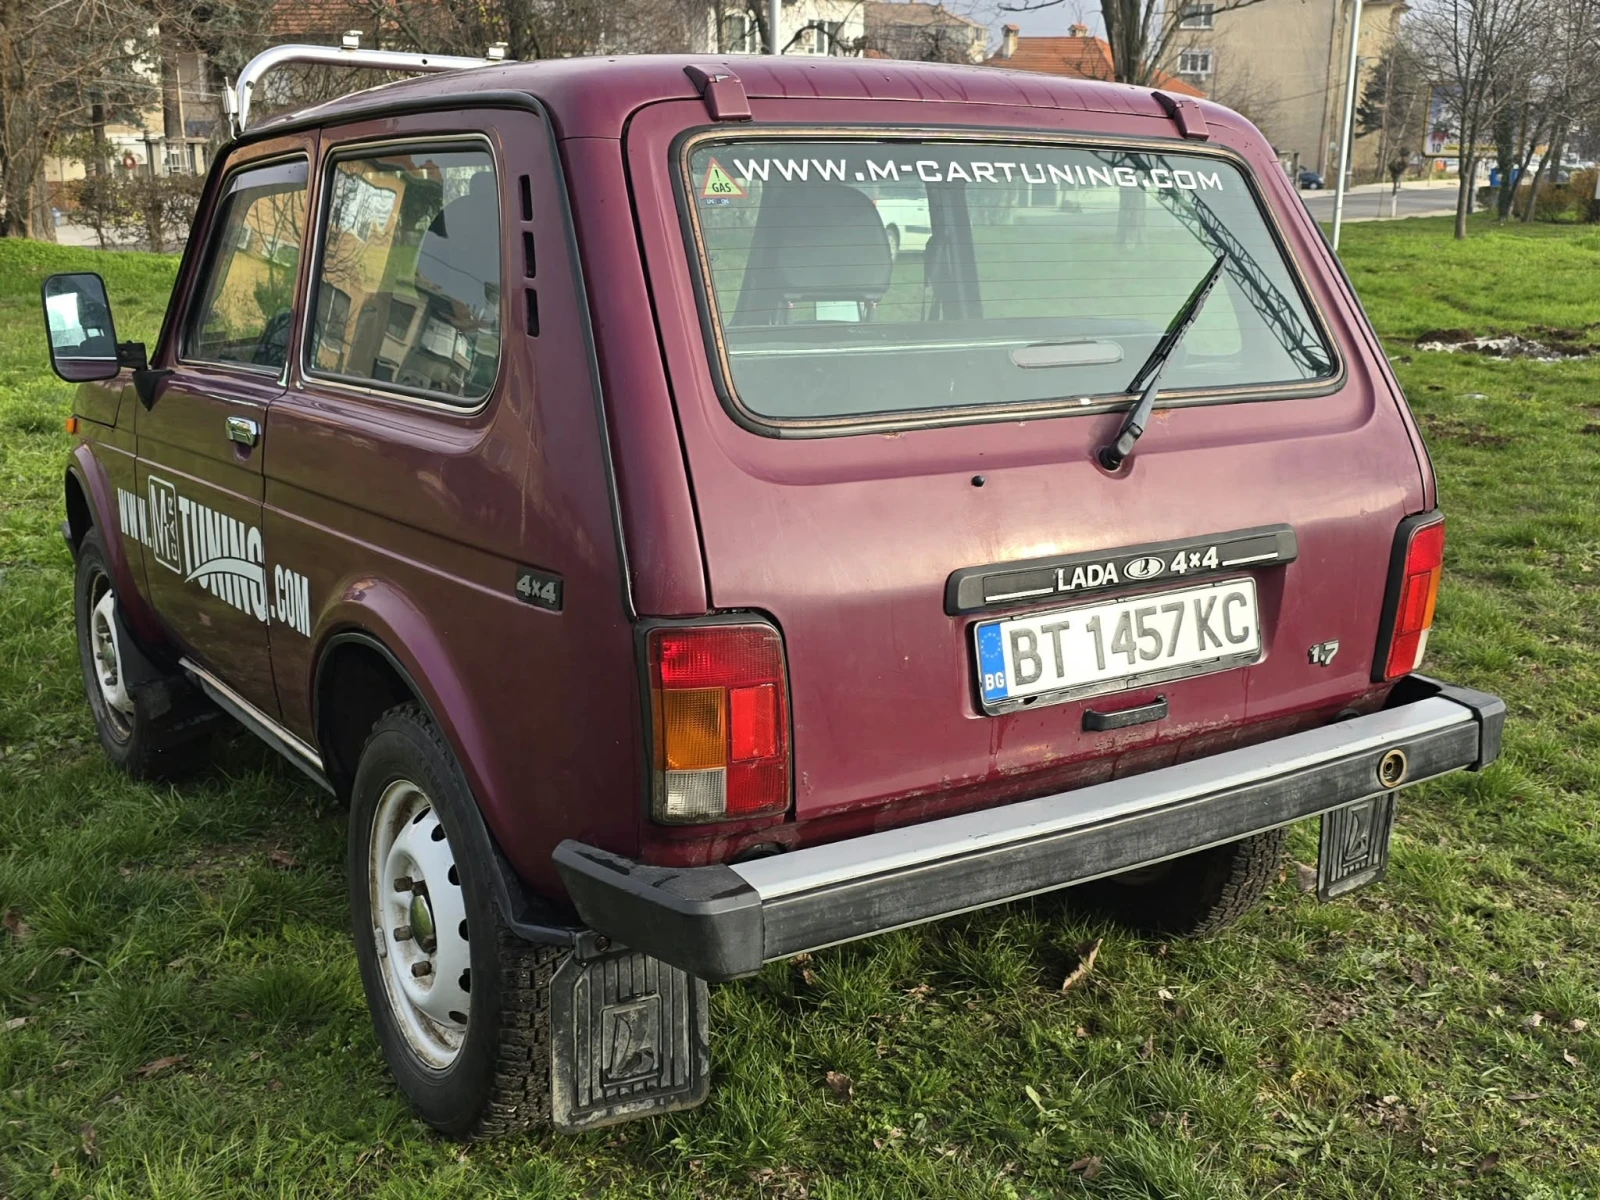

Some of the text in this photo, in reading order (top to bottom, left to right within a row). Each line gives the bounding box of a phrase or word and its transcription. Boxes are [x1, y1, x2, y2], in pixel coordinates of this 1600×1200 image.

[711, 182, 732, 193] GAS
[1057, 563, 1119, 591] LADA
[1009, 591, 1250, 687] BT 1457 KC
[985, 673, 1005, 691] BG
